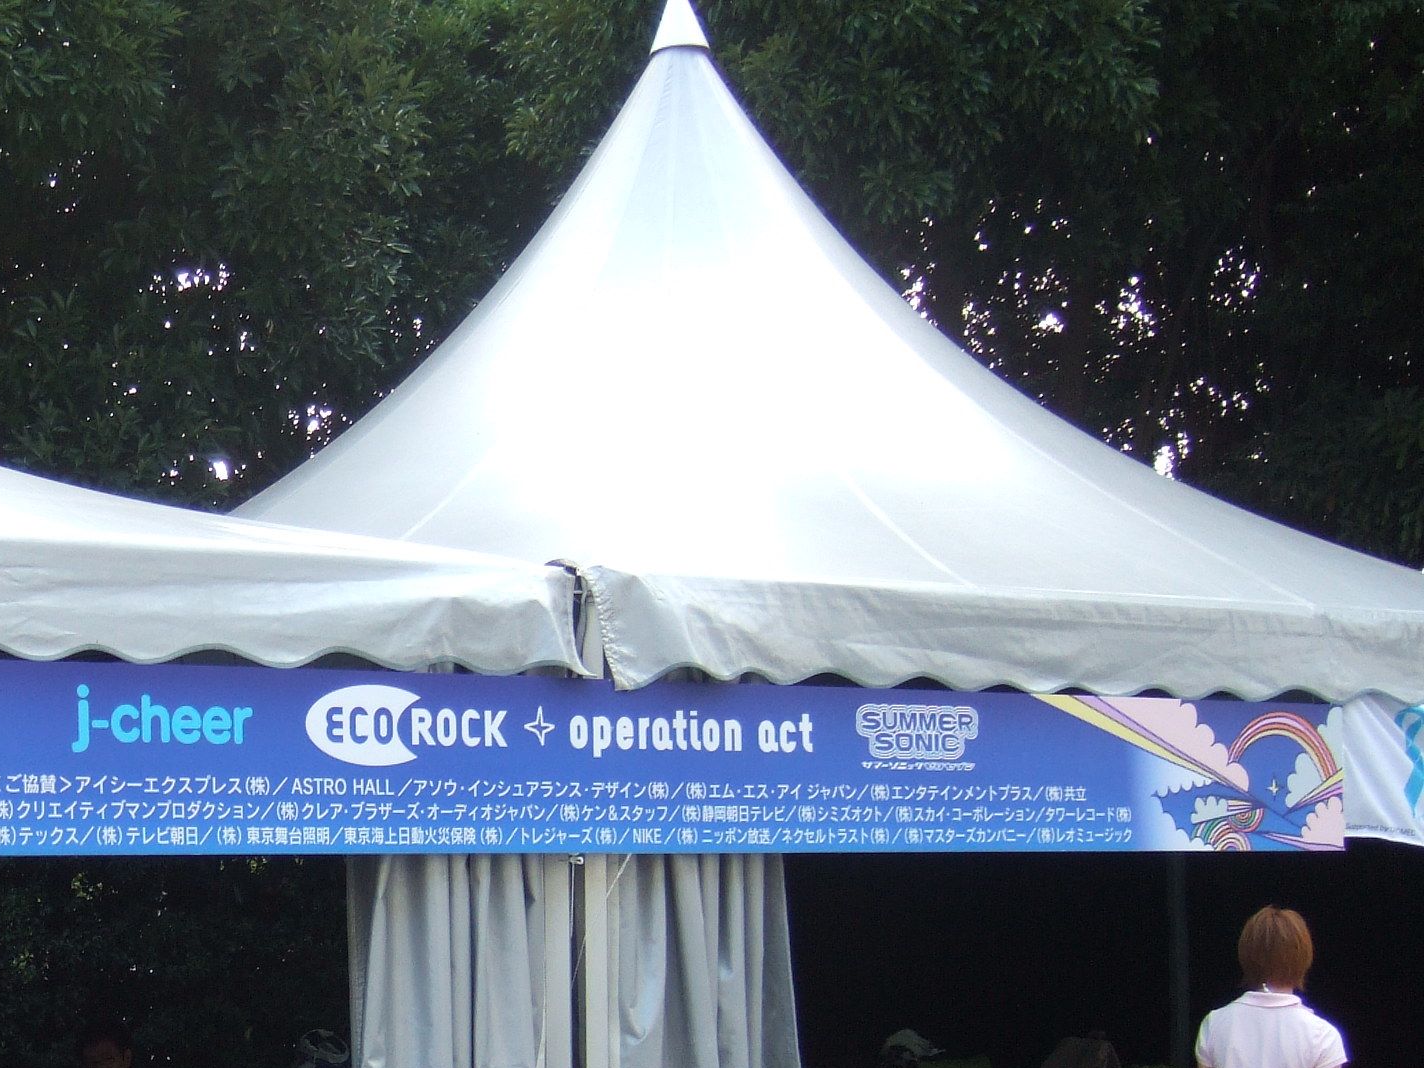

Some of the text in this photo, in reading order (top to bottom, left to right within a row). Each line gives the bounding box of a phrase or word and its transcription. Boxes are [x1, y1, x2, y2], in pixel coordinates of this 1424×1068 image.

[72, 684, 253, 753] j-cheer
[861, 710, 974, 733] SUMMER
[569, 710, 814, 758] operation act
[874, 732, 960, 753] SONIC
[291, 777, 347, 796] ASTRO
[353, 778, 395, 796] HALL
